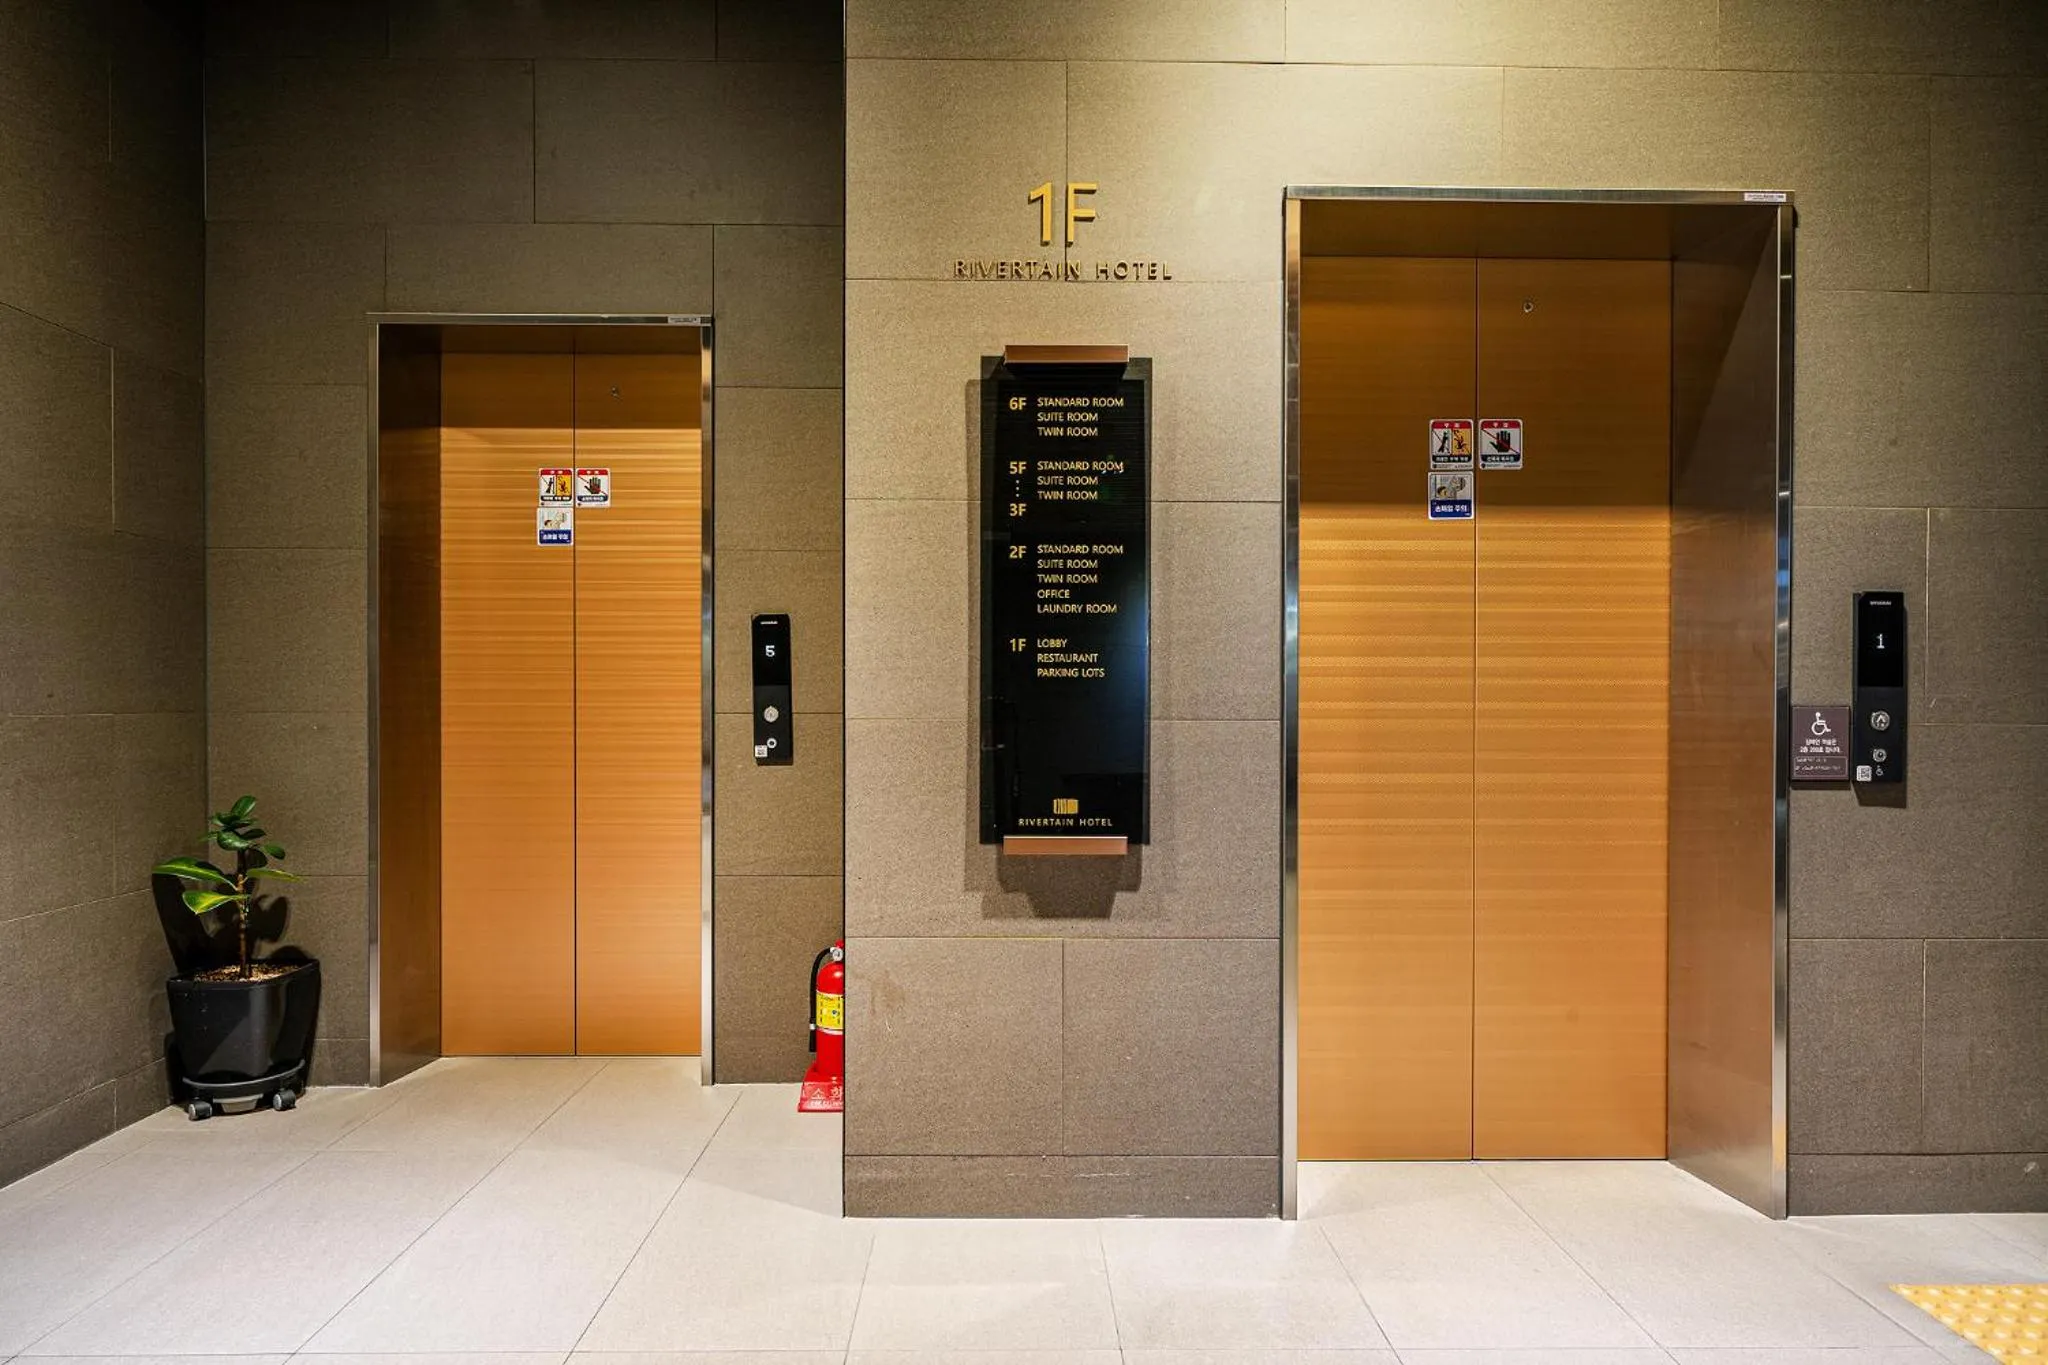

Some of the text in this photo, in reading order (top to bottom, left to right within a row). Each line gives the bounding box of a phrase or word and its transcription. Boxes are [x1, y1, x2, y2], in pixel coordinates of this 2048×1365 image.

[1028, 181, 1097, 246] 1F
[954, 260, 1172, 280] RIVERTAIN HOTEL
[1009, 397, 1026, 411] 6F
[1036, 397, 1124, 408] STANDARD ROOM
[1036, 412, 1098, 422] SUITE ROOM
[1037, 427, 1098, 437] TWIN ROOM
[1009, 462, 1026, 475] 5F
[1036, 461, 1124, 471] STANDARD ROOM
[1036, 476, 1098, 486] SUITE ROOM
[1037, 491, 1097, 501] TWIN ROOM
[1009, 503, 1026, 517] 3F
[1009, 546, 1026, 559] 2F
[1037, 545, 1123, 555] STANDARD ROOM
[1037, 559, 1097, 569] SUITE ROOM
[1036, 574, 1097, 584] TWIN ROOM
[1036, 589, 1069, 599] OFFICE
[1037, 604, 1117, 614] LAUNDRY ROOM
[1009, 639, 1026, 652] 1F
[1036, 639, 1067, 648] LOBBY
[1876, 633, 1885, 649] 1
[765, 645, 776, 662] 5
[1036, 653, 1098, 663] RESTAURANT
[1037, 668, 1105, 678] PARKING LOTS
[1018, 819, 1112, 827] RIVERTAIN HOTEL
